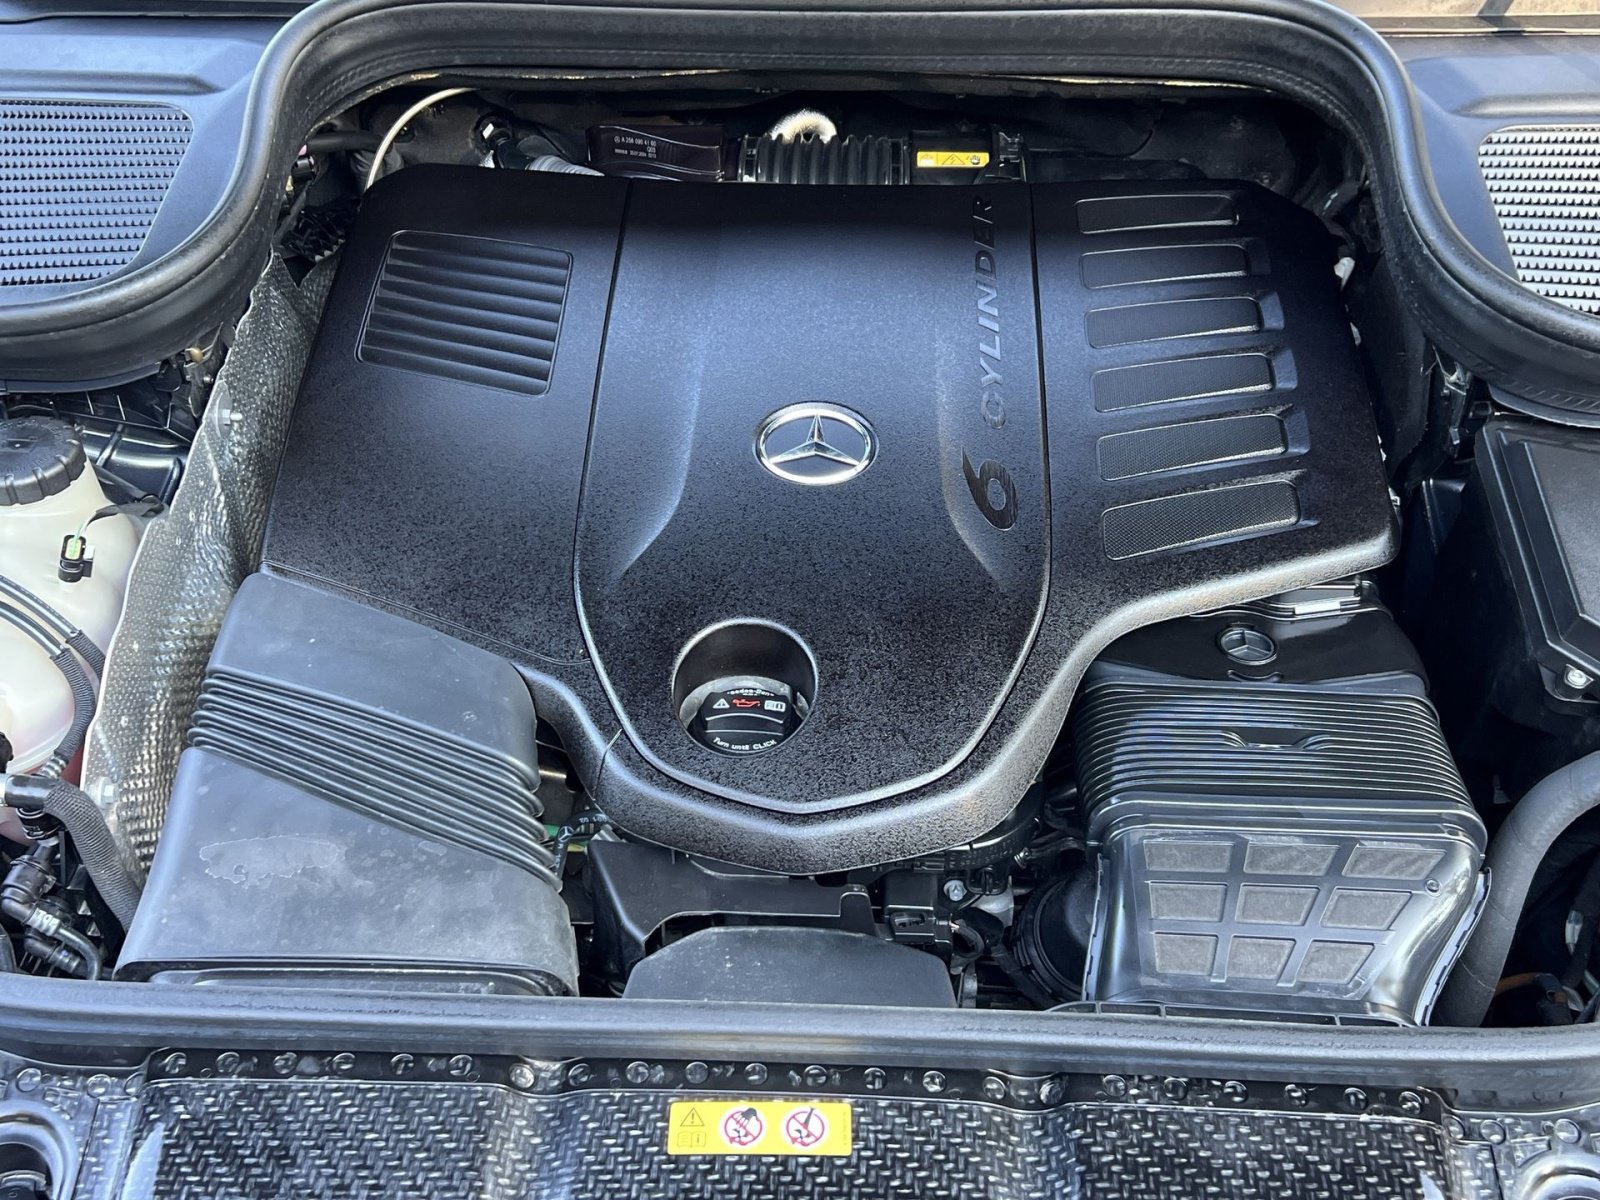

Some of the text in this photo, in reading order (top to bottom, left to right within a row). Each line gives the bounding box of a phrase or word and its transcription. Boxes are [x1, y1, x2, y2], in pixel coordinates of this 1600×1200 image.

[961, 195, 1019, 531] 6 CYLINDER
[713, 737, 730, 748] Turn
[752, 739, 778, 750] CLICK
